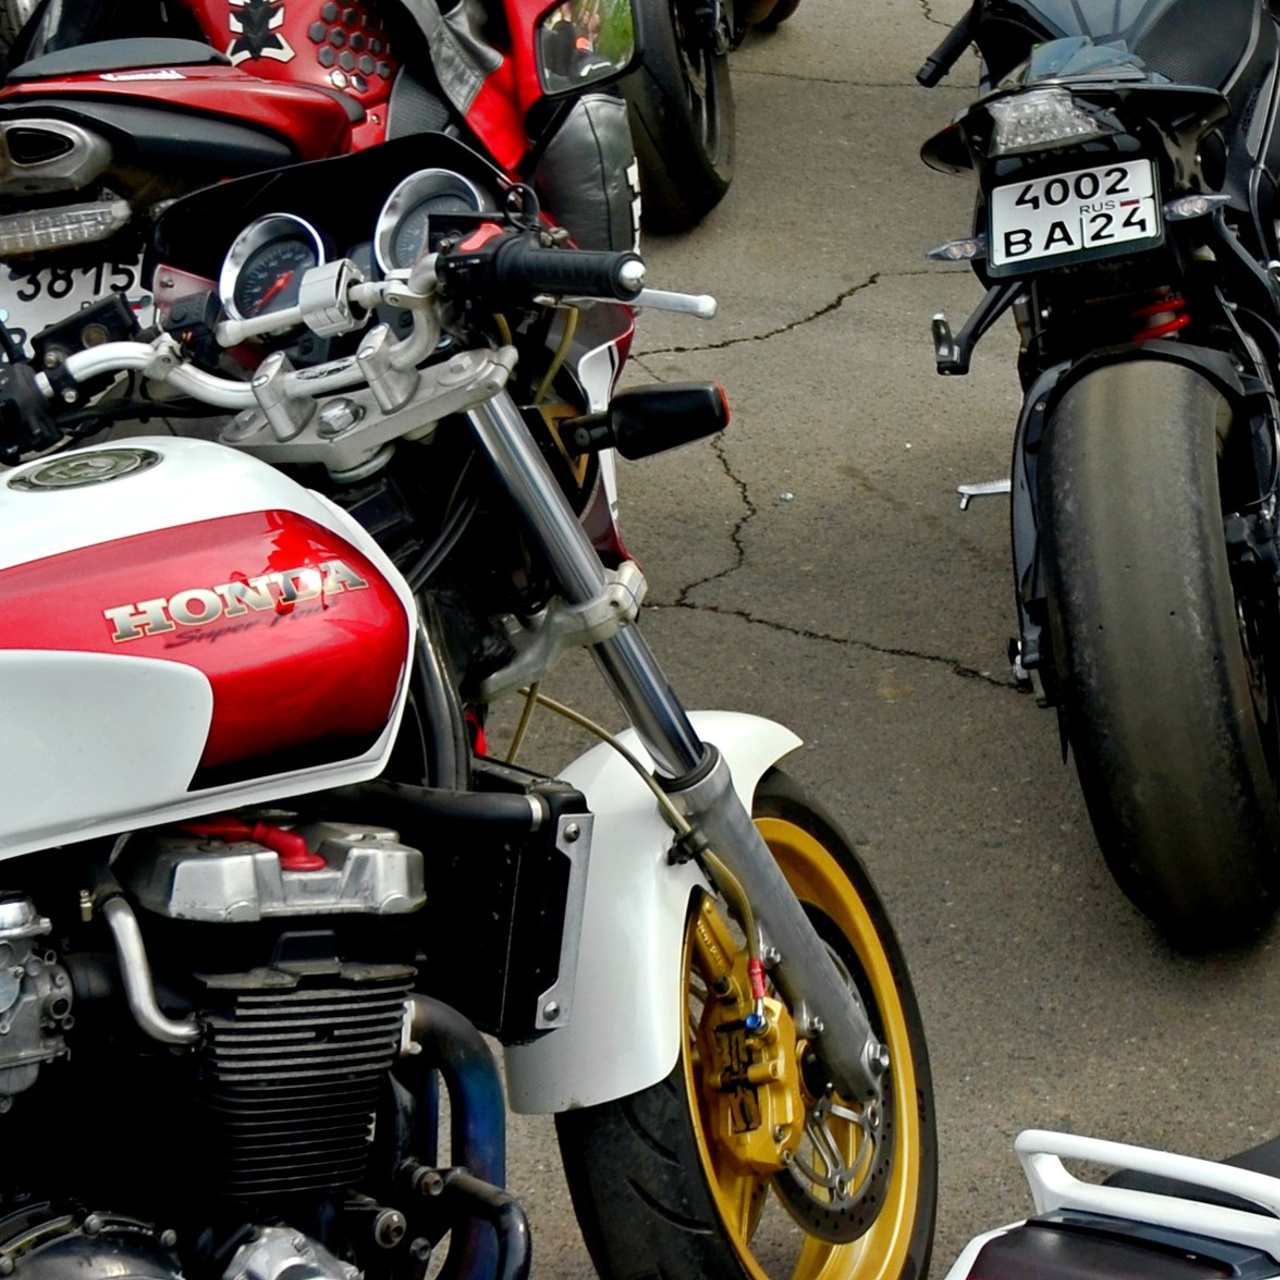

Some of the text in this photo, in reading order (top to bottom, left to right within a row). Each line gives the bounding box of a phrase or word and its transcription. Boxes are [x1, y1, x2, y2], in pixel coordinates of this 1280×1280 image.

[1015, 167, 1130, 210] 4002
[1079, 200, 1116, 216] RUS
[1003, 206, 1147, 258] BA 24
[104, 560, 369, 642] HONDA
